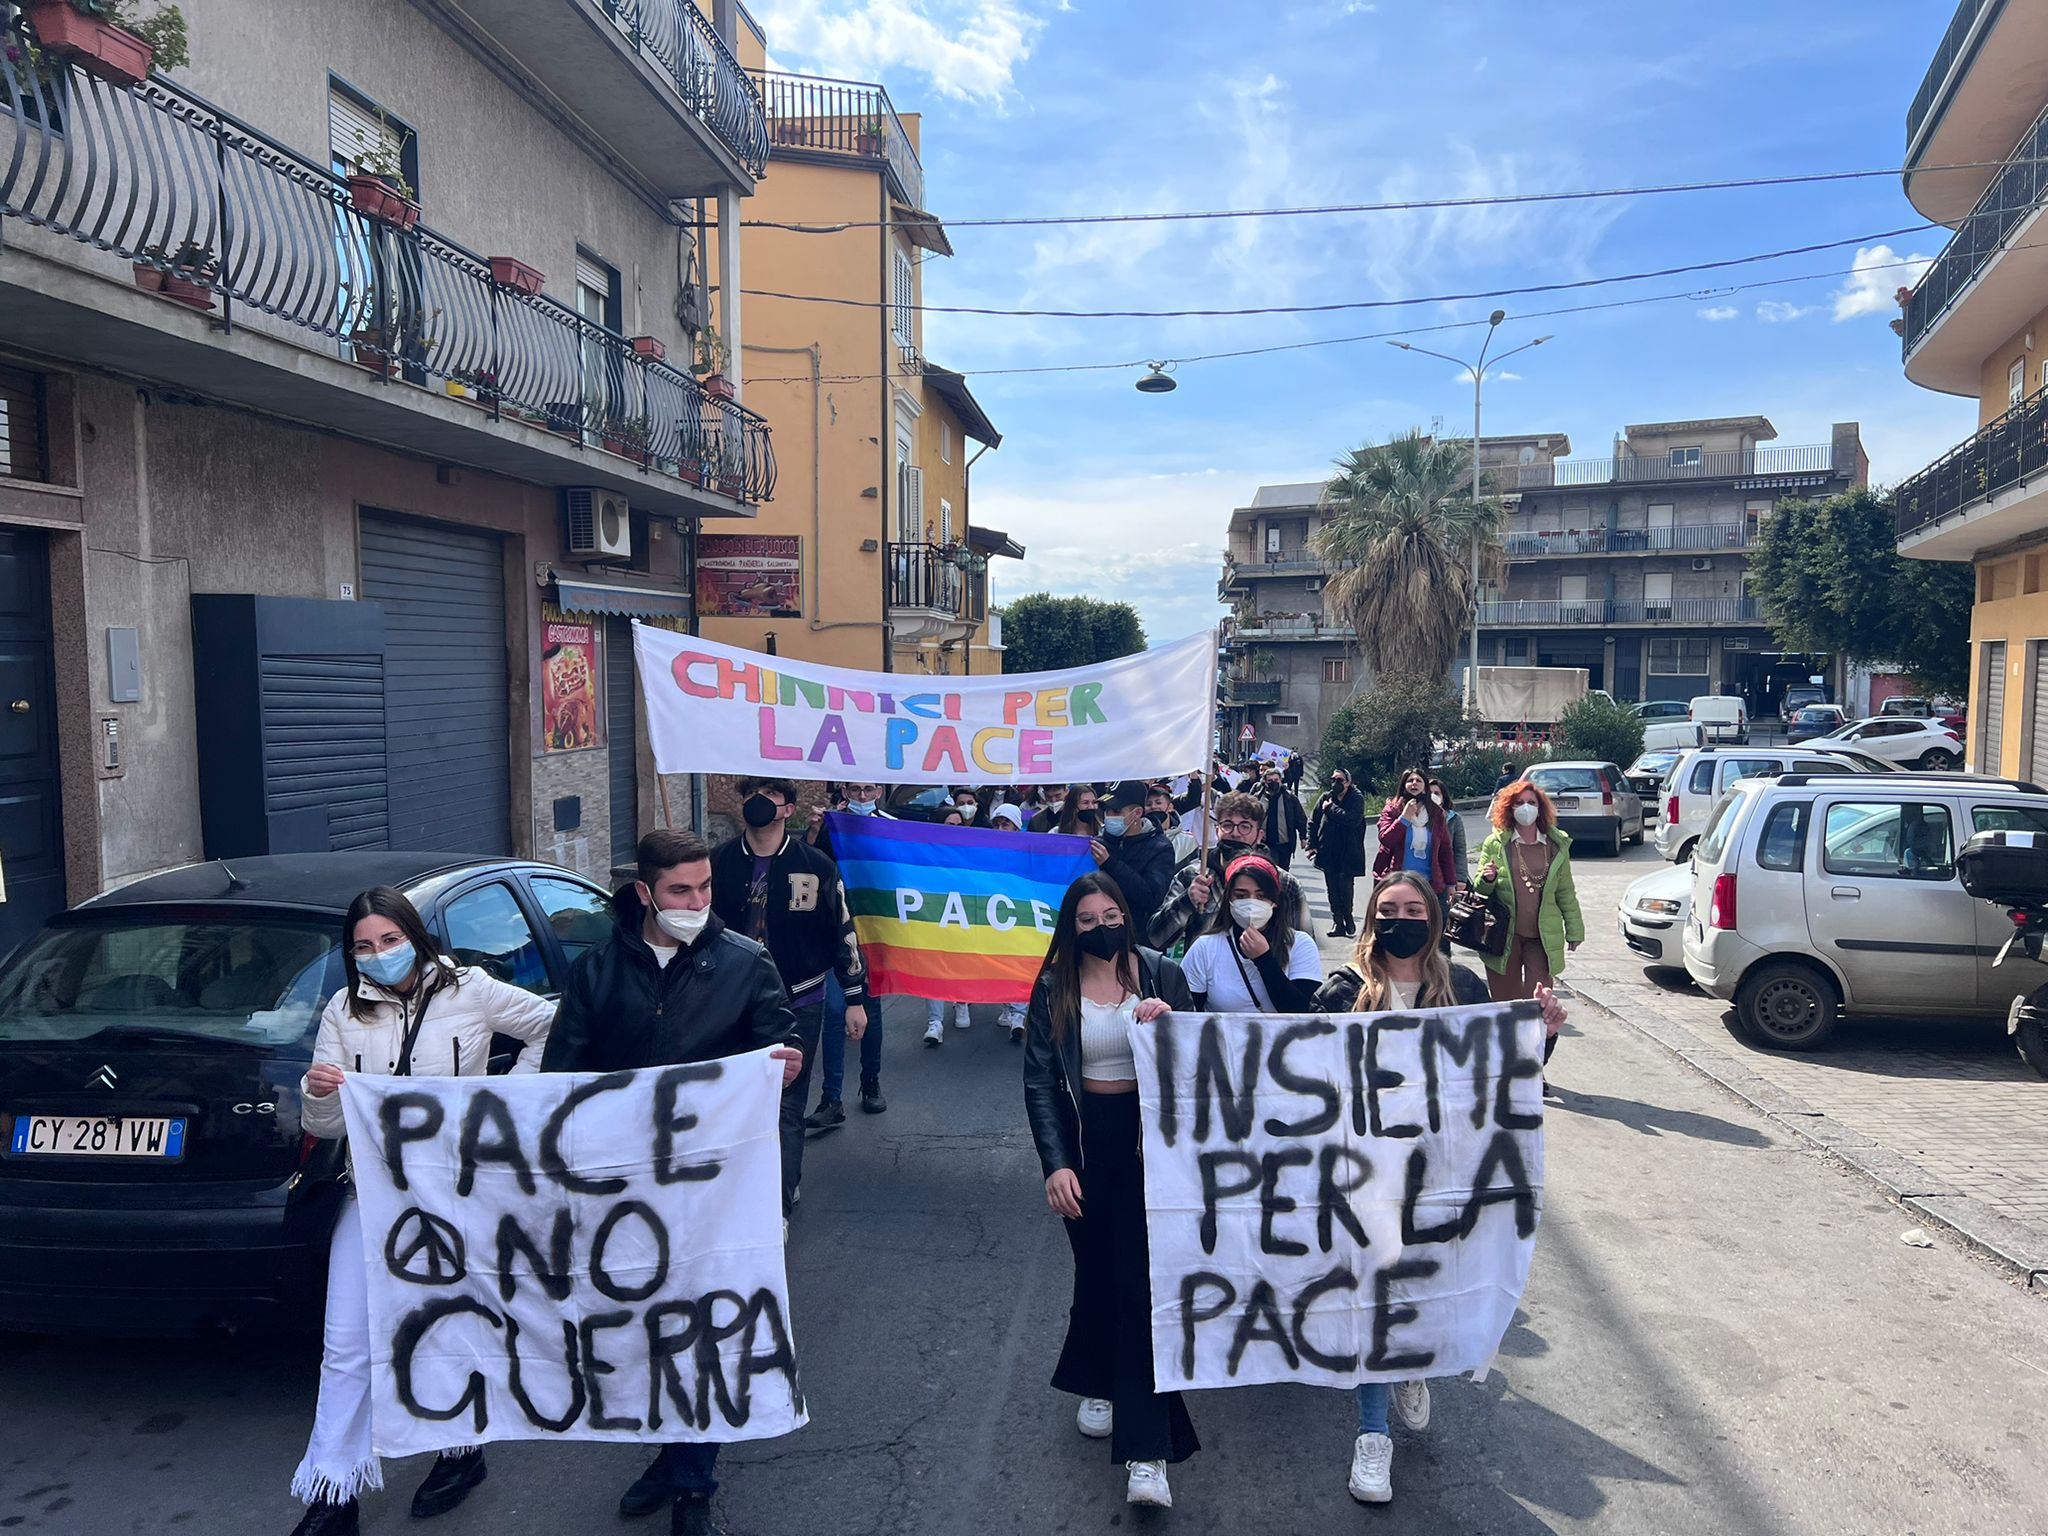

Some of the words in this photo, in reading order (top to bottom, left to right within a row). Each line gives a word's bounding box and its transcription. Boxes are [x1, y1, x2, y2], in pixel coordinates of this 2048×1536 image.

[343, 586, 351, 595] 75
[671, 650, 961, 721] CHINNICI
[1003, 681, 1108, 726] PER
[757, 706, 856, 766] LA
[885, 717, 1053, 774] PACE
[896, 887, 1056, 935] PACE
[232, 1102, 275, 1114] C3
[1155, 999, 1544, 1148] INSIEME
[378, 1060, 723, 1197] PACE
[1197, 1144, 1375, 1256] PER
[1401, 1130, 1537, 1246] LA
[494, 1200, 670, 1302] NO
[391, 1287, 805, 1434] GUERRA
[1179, 1258, 1440, 1381] PACE
